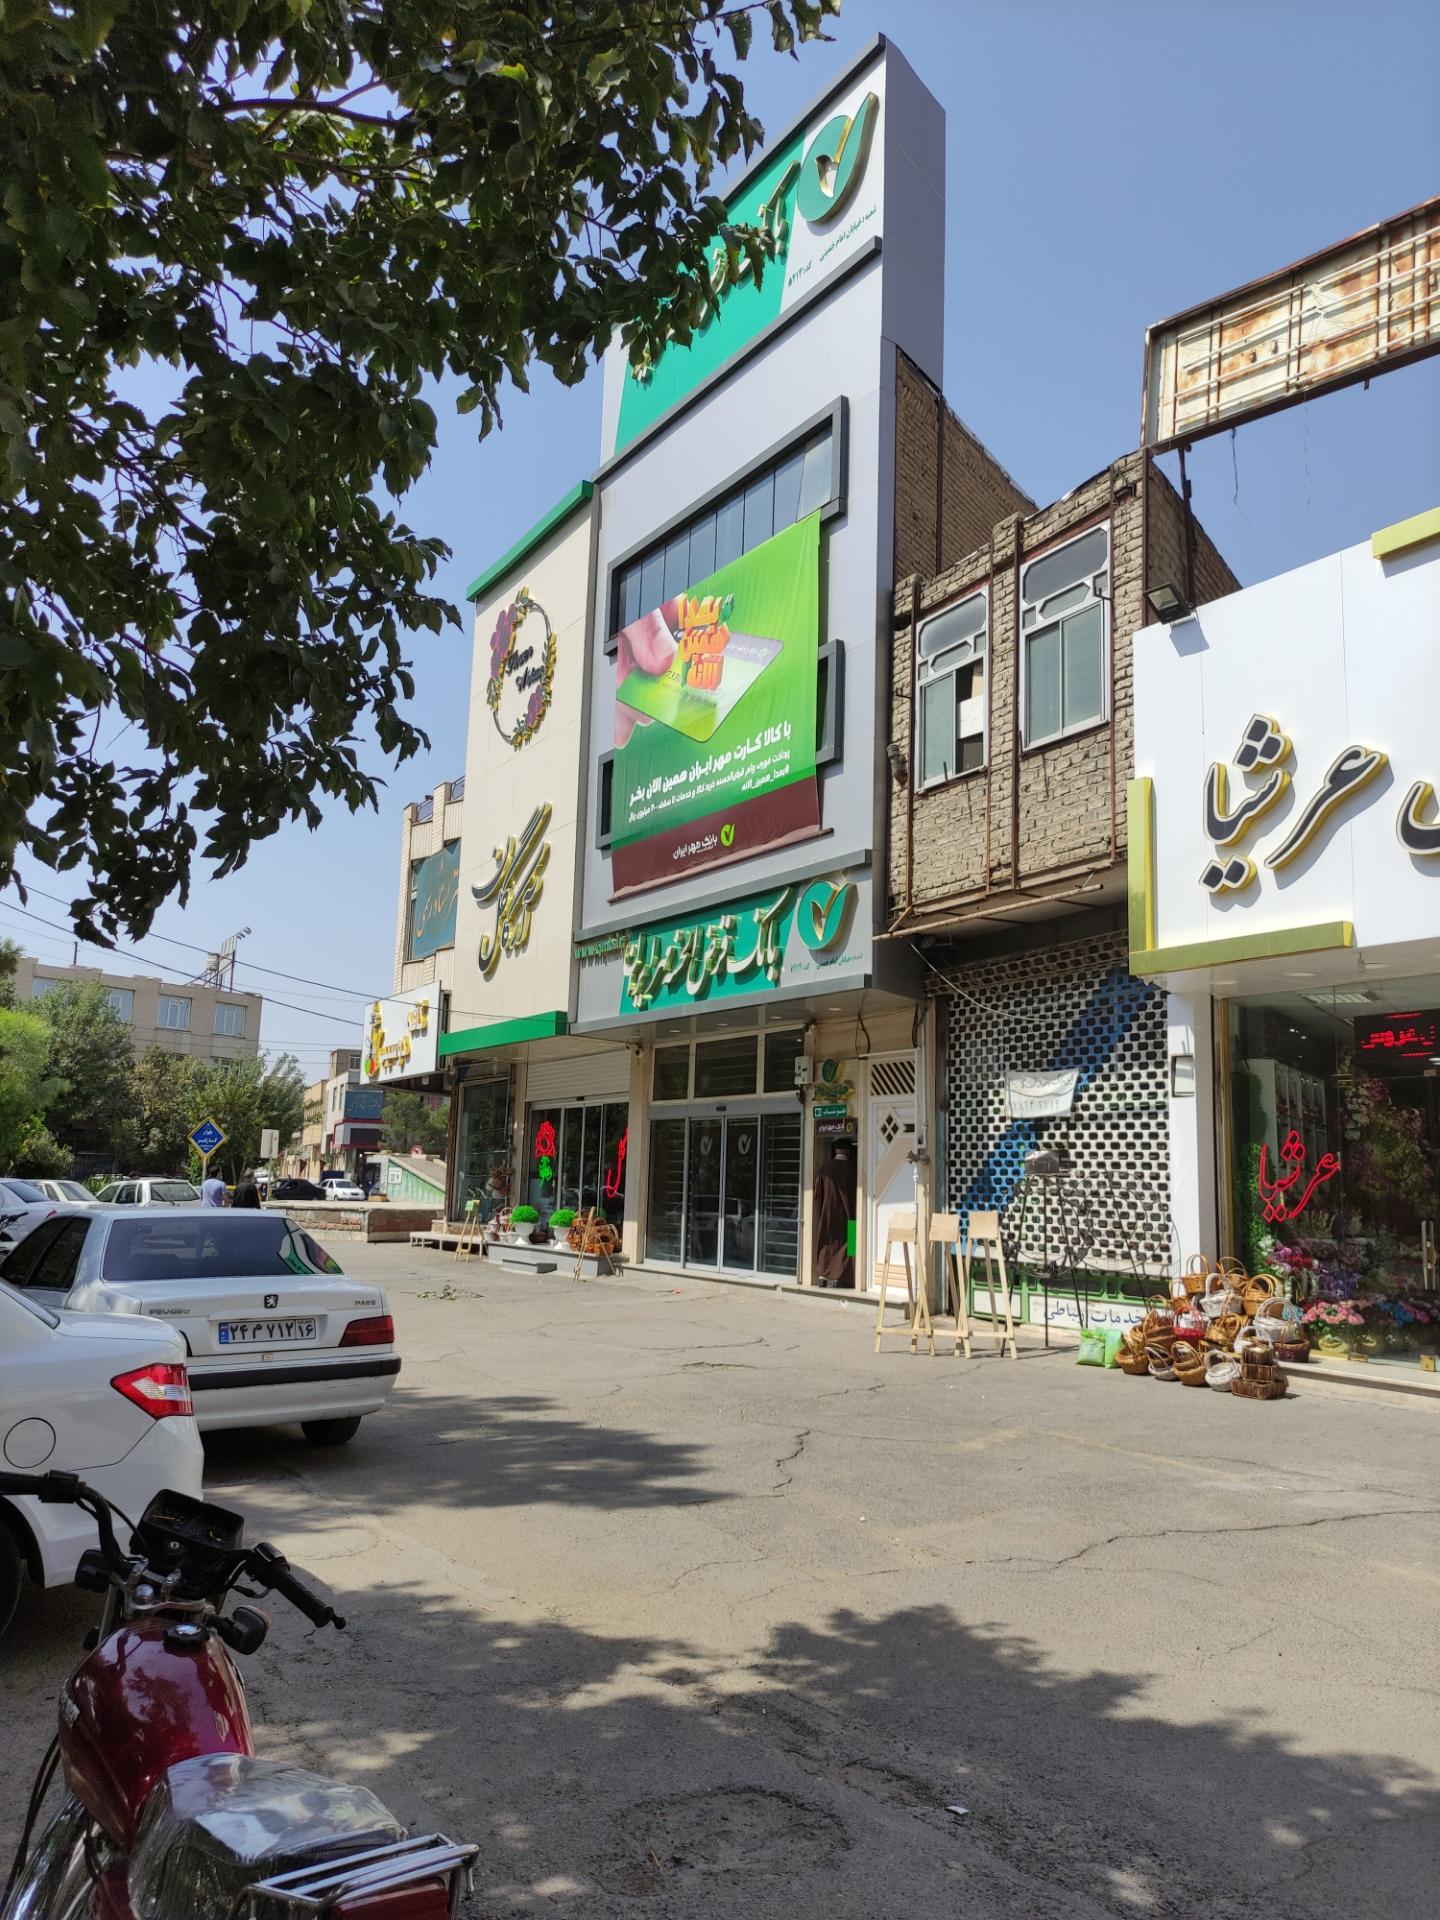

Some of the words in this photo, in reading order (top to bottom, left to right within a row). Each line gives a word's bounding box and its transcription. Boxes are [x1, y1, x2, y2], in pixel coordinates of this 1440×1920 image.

[764, 722, 782, 746] کالا
[784, 720, 792, 740] با
[733, 732, 762, 761] کارت
[689, 754, 713, 783] ایران
[712, 751, 732, 773] مهر
[662, 770, 688, 793] همین
[629, 785, 646, 807] بخر
[1198, 712, 1390, 895] عرشیا
[672, 843, 688, 859] ایران
[687, 840, 701, 855] مهر
[701, 834, 718, 847] بانک
[726, 887, 791, 983] بانک
[1258, 1129, 1342, 1223] عرشیا
